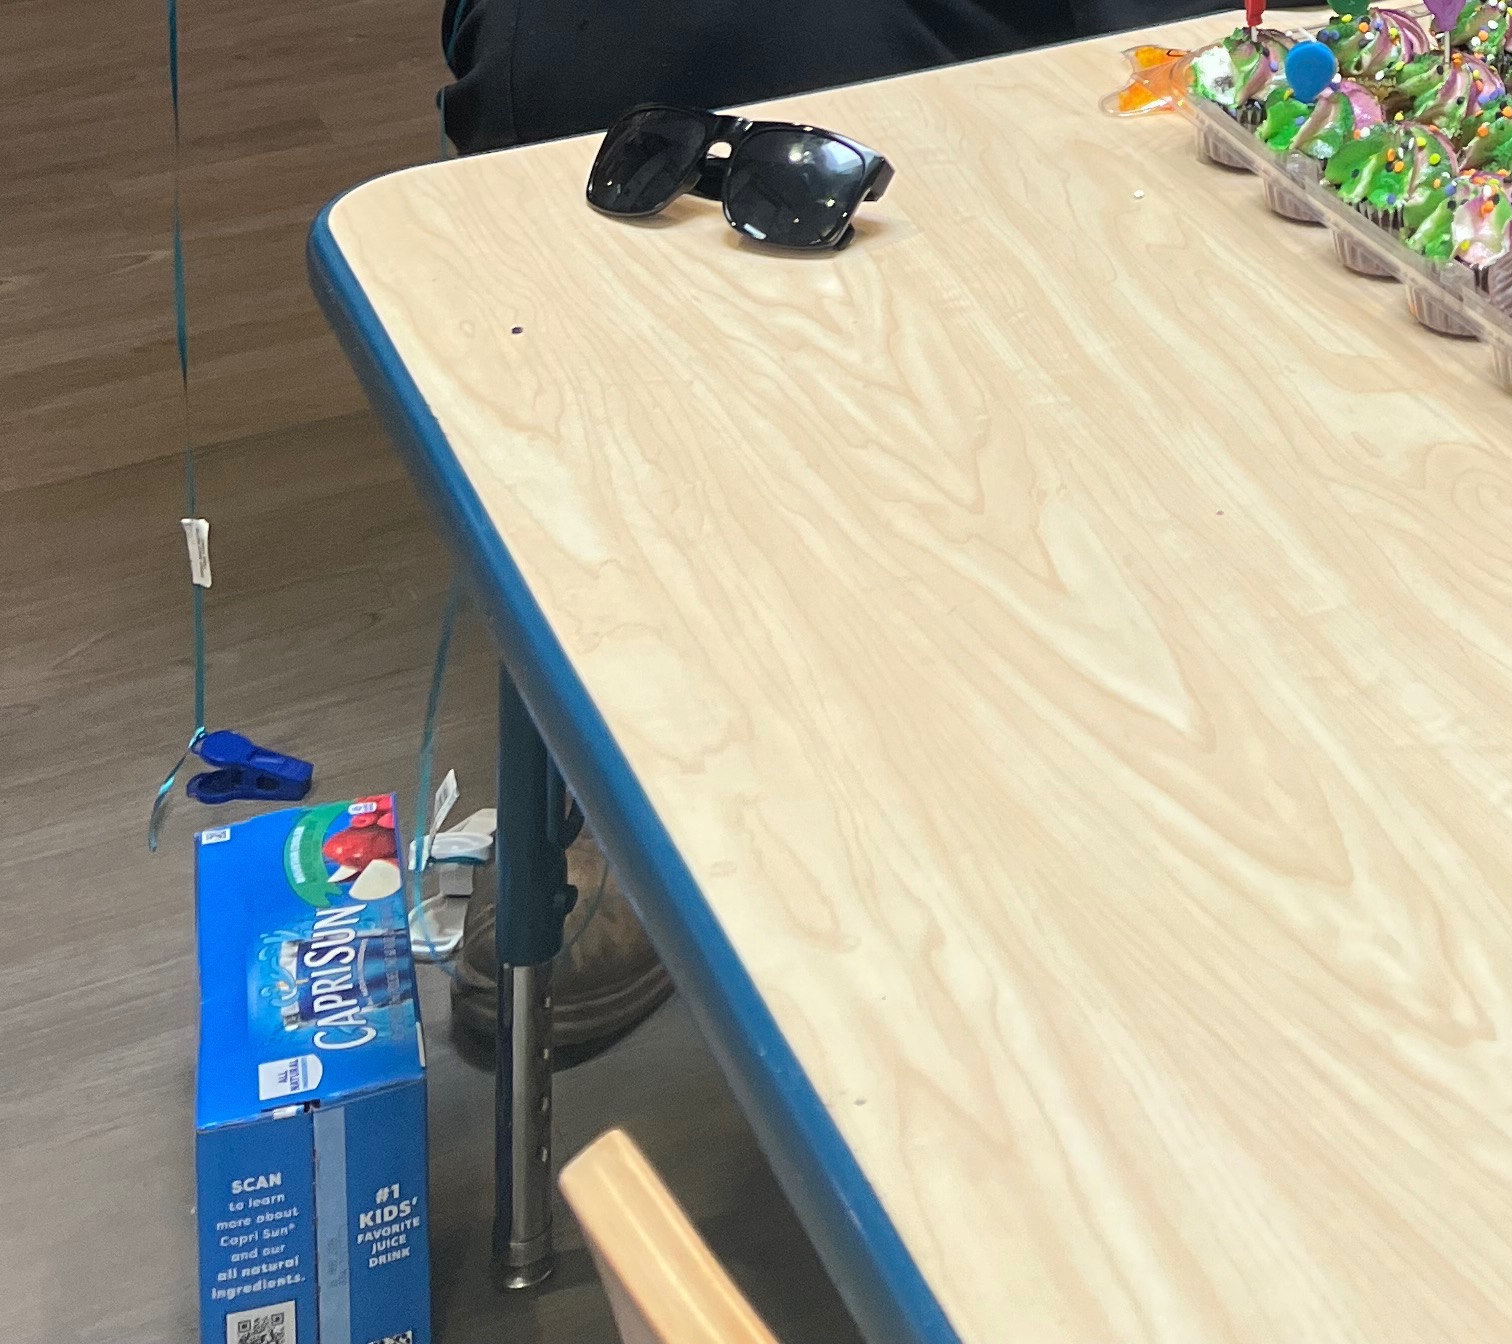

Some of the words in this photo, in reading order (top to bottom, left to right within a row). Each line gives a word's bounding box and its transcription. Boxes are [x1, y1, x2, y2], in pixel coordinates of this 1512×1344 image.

[278, 1069, 289, 1084] ALL
[290, 1058, 300, 1092] NATURAL
[231, 1171, 282, 1195] SCAN
[375, 1183, 400, 1204] #1
[229, 1201, 245, 1212] to
[248, 1193, 285, 1208] learn
[216, 1216, 251, 1231] more
[256, 1206, 300, 1224] about
[220, 1230, 259, 1247] Capri
[357, 1216, 420, 1244] FAVORITE
[231, 1247, 258, 1263] and
[262, 1244, 286, 1257] our
[371, 1233, 407, 1255] JUICE
[217, 1267, 238, 1281] all
[241, 1255, 299, 1278] natural
[368, 1247, 410, 1268] DRINK
